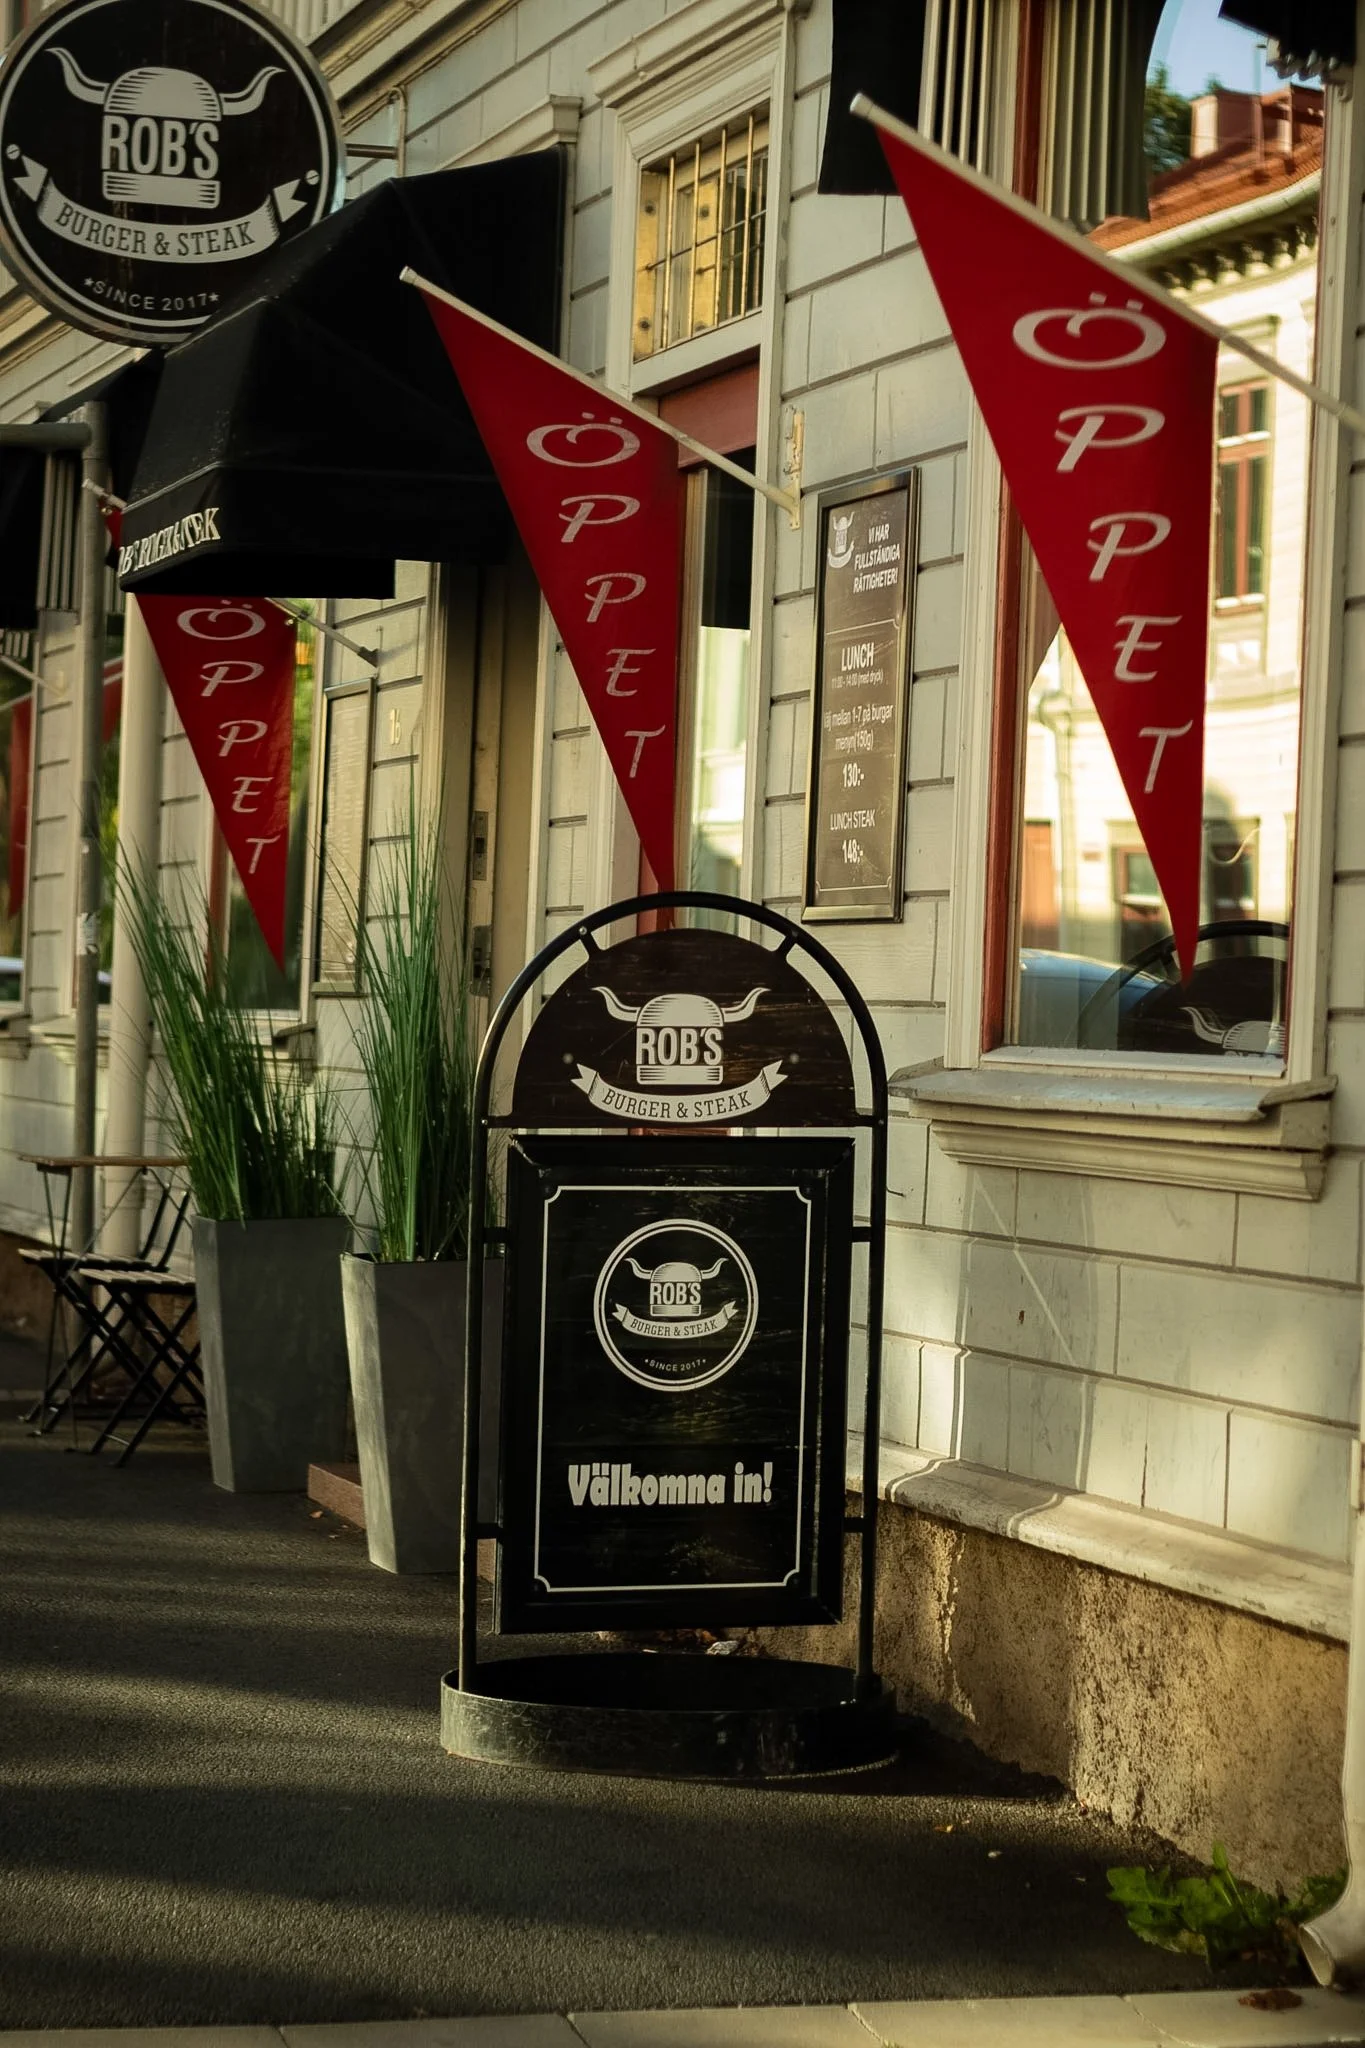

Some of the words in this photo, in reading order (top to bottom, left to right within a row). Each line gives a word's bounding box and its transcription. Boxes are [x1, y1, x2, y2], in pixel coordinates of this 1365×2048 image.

[102, 115, 220, 179] ROB'S
[55, 202, 147, 254] BURGER
[154, 234, 171, 256] &
[178, 220, 255, 256] STEAK
[92, 280, 155, 310] SINCE
[162, 293, 208, 311] 2017
[875, 523, 890, 543] HAR
[1013, 291, 1194, 794] ÖPPET
[854, 542, 901, 571] FULLSTÄNDIGA
[526, 412, 667, 778] ÖPPET
[841, 642, 875, 671] LUNCH
[852, 705, 863, 723] 1-7
[177, 600, 282, 875] ÖPPET
[843, 763, 865, 788] 130:-
[830, 812, 853, 831] LUNCH
[853, 809, 876, 829] STEAK
[842, 839, 864, 864] 148:-
[636, 1027, 724, 1065] ROB'S
[602, 1088, 671, 1118] BURGER
[676, 1103, 689, 1118] &
[694, 1090, 752, 1118] STEAK
[650, 1282, 701, 1305] ROB'S
[630, 1318, 671, 1337] BURGER
[673, 1326, 681, 1336] &
[683, 1319, 718, 1336] STEAK
[649, 1359, 678, 1372] SINCE
[680, 1359, 701, 1371] 2017
[568, 1462, 726, 1506] Välkomna
[733, 1461, 773, 1503] in!
